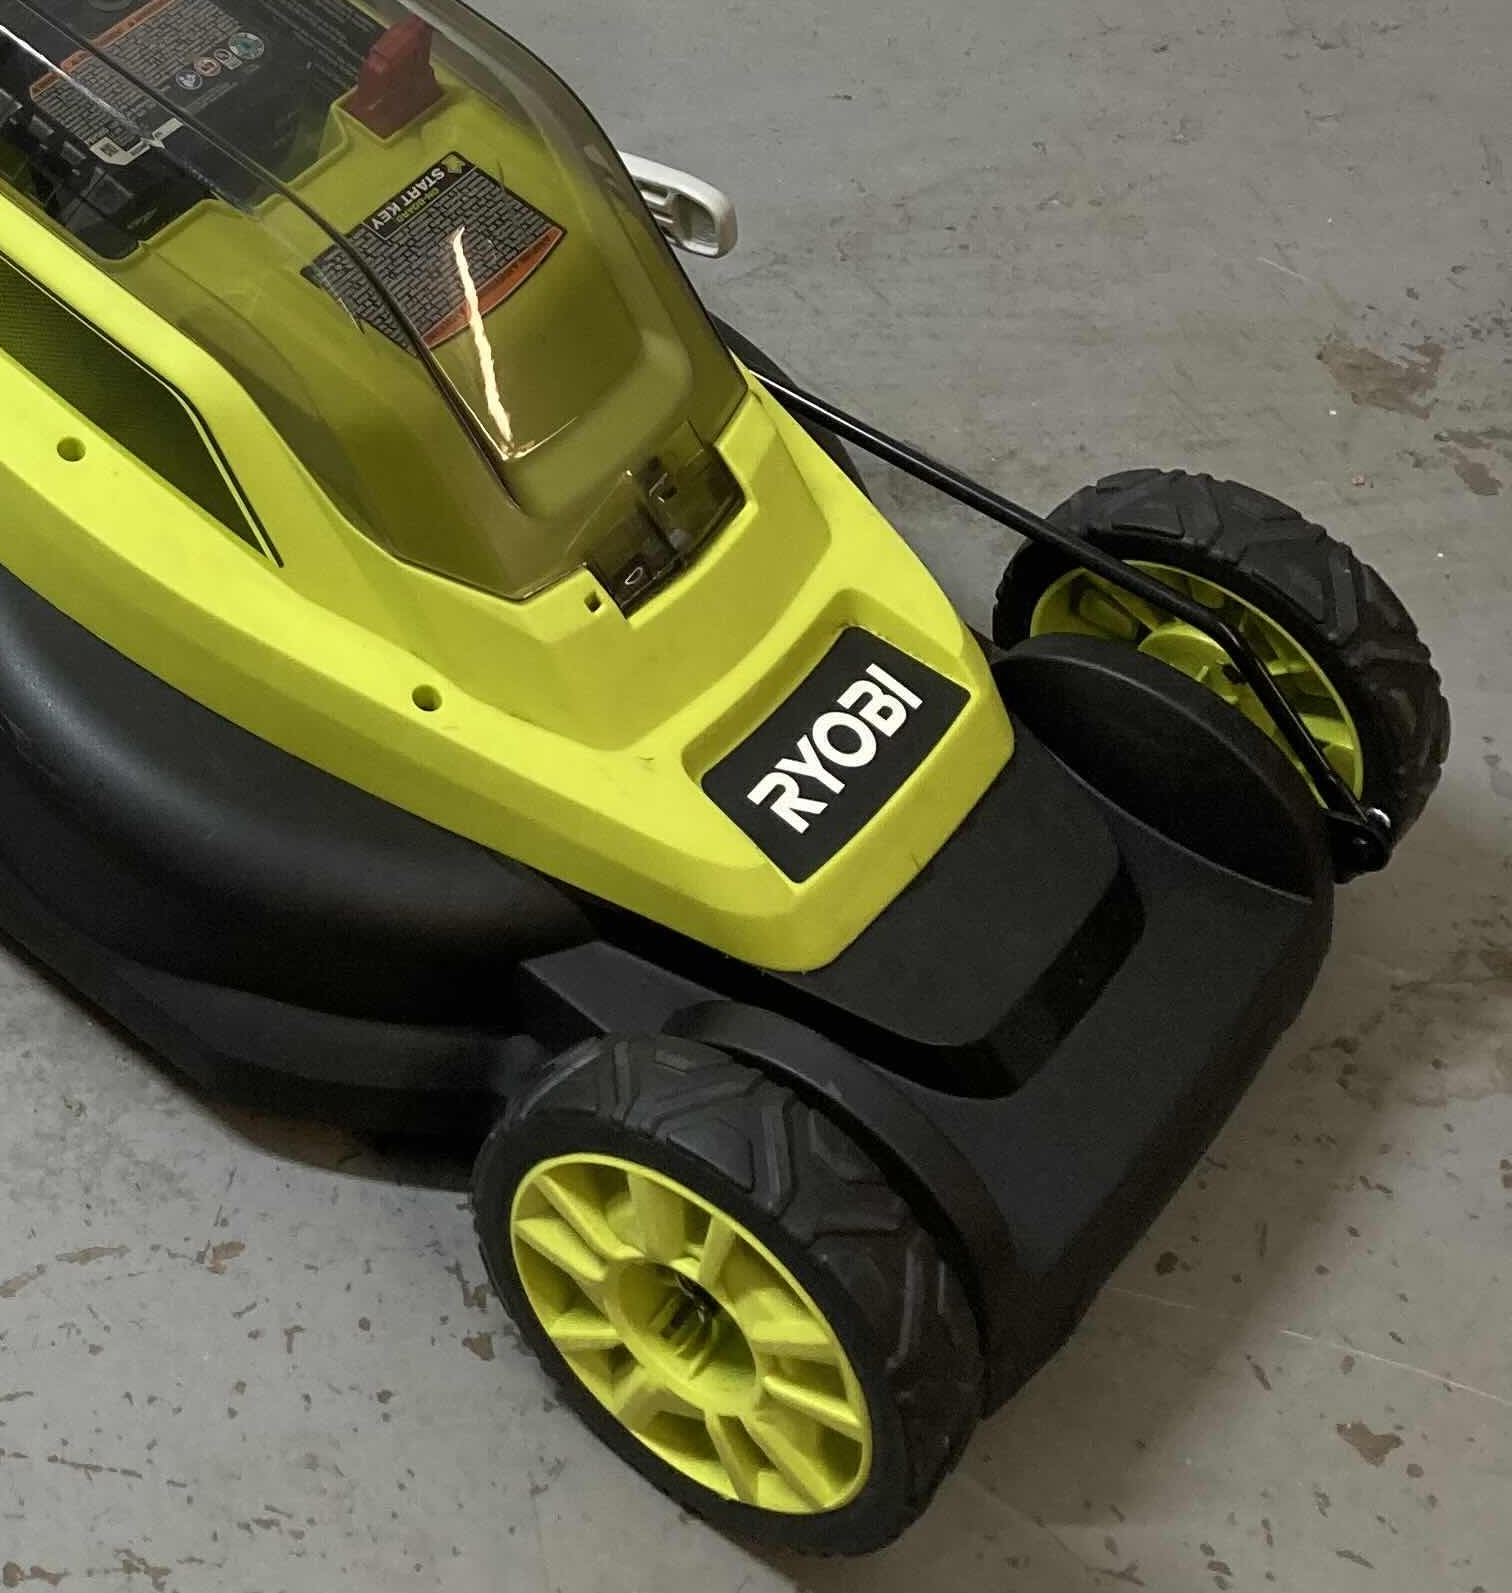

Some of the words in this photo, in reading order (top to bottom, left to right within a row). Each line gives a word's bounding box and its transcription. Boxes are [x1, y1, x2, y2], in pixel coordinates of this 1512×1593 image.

[401, 167, 445, 206] START
[371, 202, 401, 230] KEY
[746, 663, 923, 834] RYOBI
